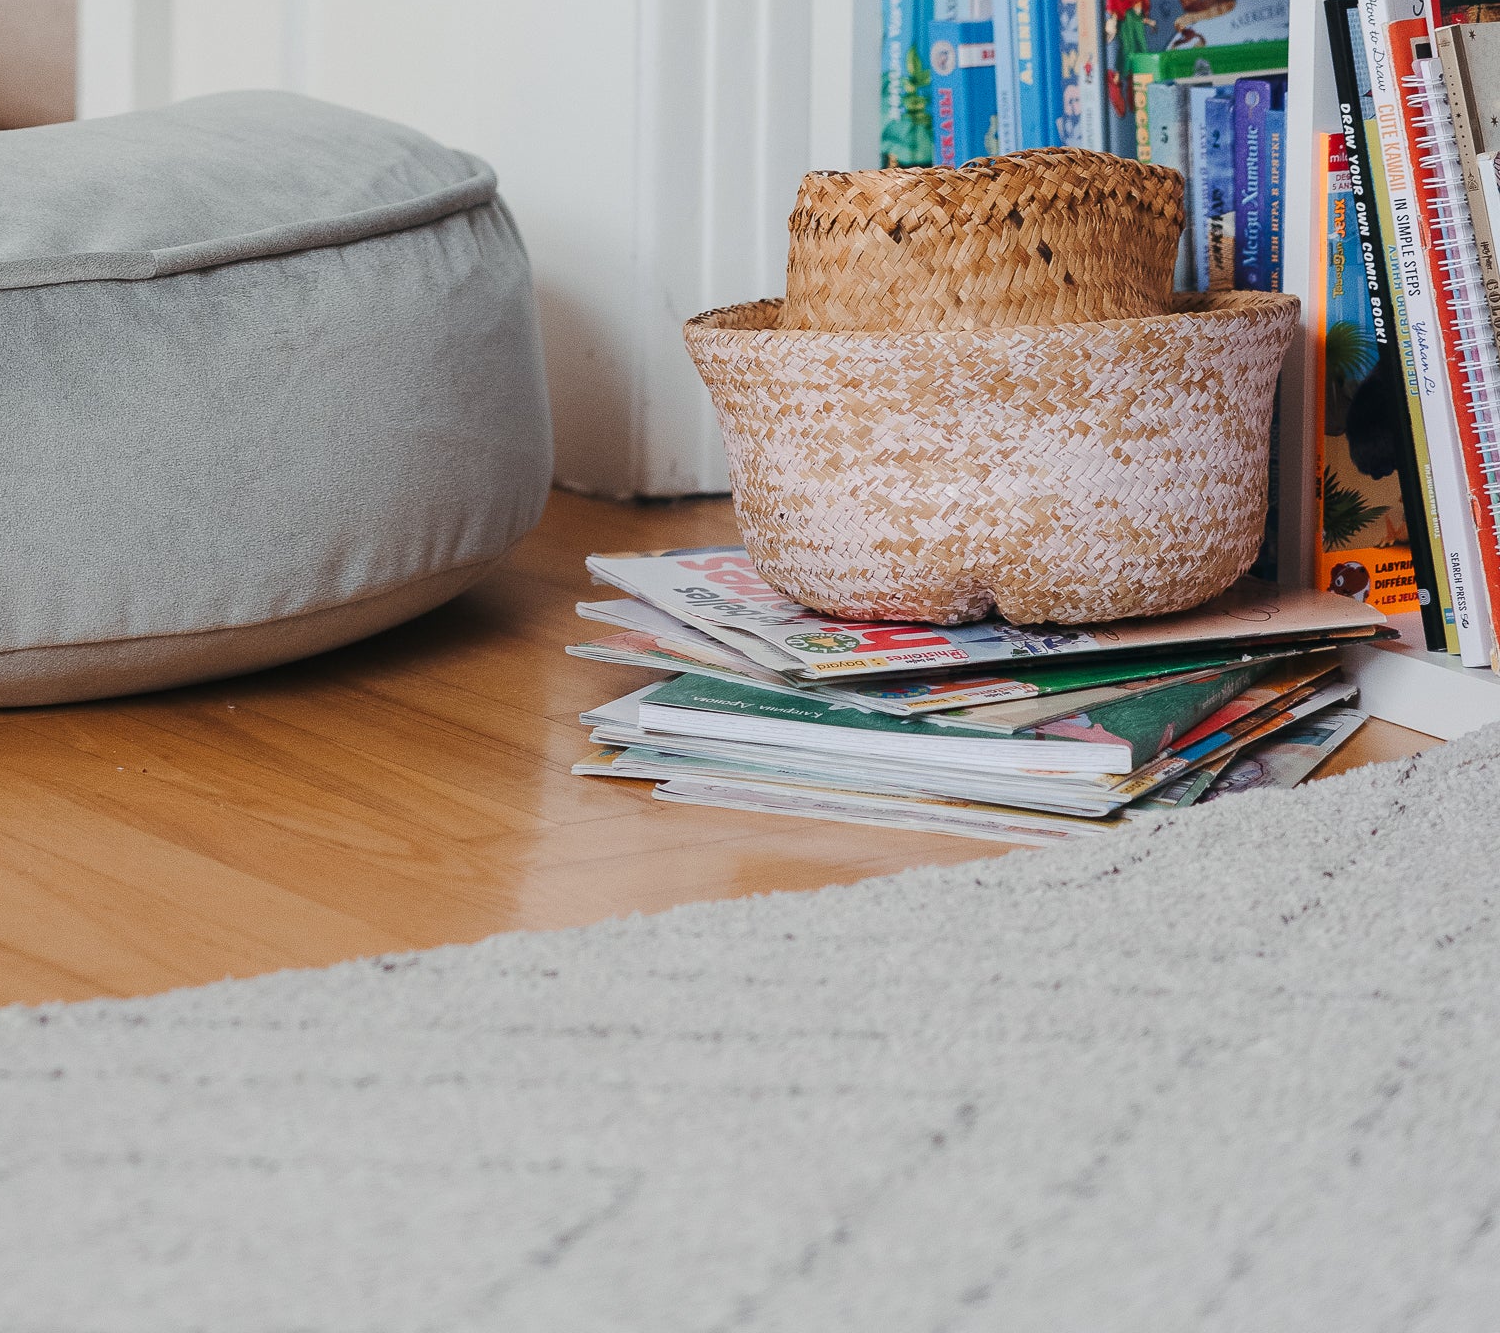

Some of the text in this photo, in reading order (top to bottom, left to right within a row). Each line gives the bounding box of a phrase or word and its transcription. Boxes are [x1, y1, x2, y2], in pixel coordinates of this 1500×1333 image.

[1369, 32, 1380, 43] to
[1372, 46, 1387, 92] Draw
[1377, 104, 1397, 139] CUTE
[1272, 132, 1280, 185] ПРЯТКИ
[1383, 142, 1407, 191] KAWAII
[1272, 188, 1280, 198] В
[1393, 198, 1407, 211] IN
[1271, 200, 1280, 233] ИГРА
[1340, 103, 1388, 344] DRAW YOUR OWN COMIC BOOK!
[1242, 210, 1261, 267] Мейзи
[1271, 240, 1280, 263] ИЛИ
[1396, 214, 1415, 257] SIMPLE
[1403, 260, 1420, 297] STEPS
[1411, 320, 1429, 373] Yishan
[1423, 376, 1436, 396] Li
[1381, 593, 1396, 605] LES
[1450, 552, 1467, 612] SEARCH PRESS
[672, 586, 750, 622] belles
[816, 658, 867, 672] bayard
[885, 649, 950, 663] histoires
